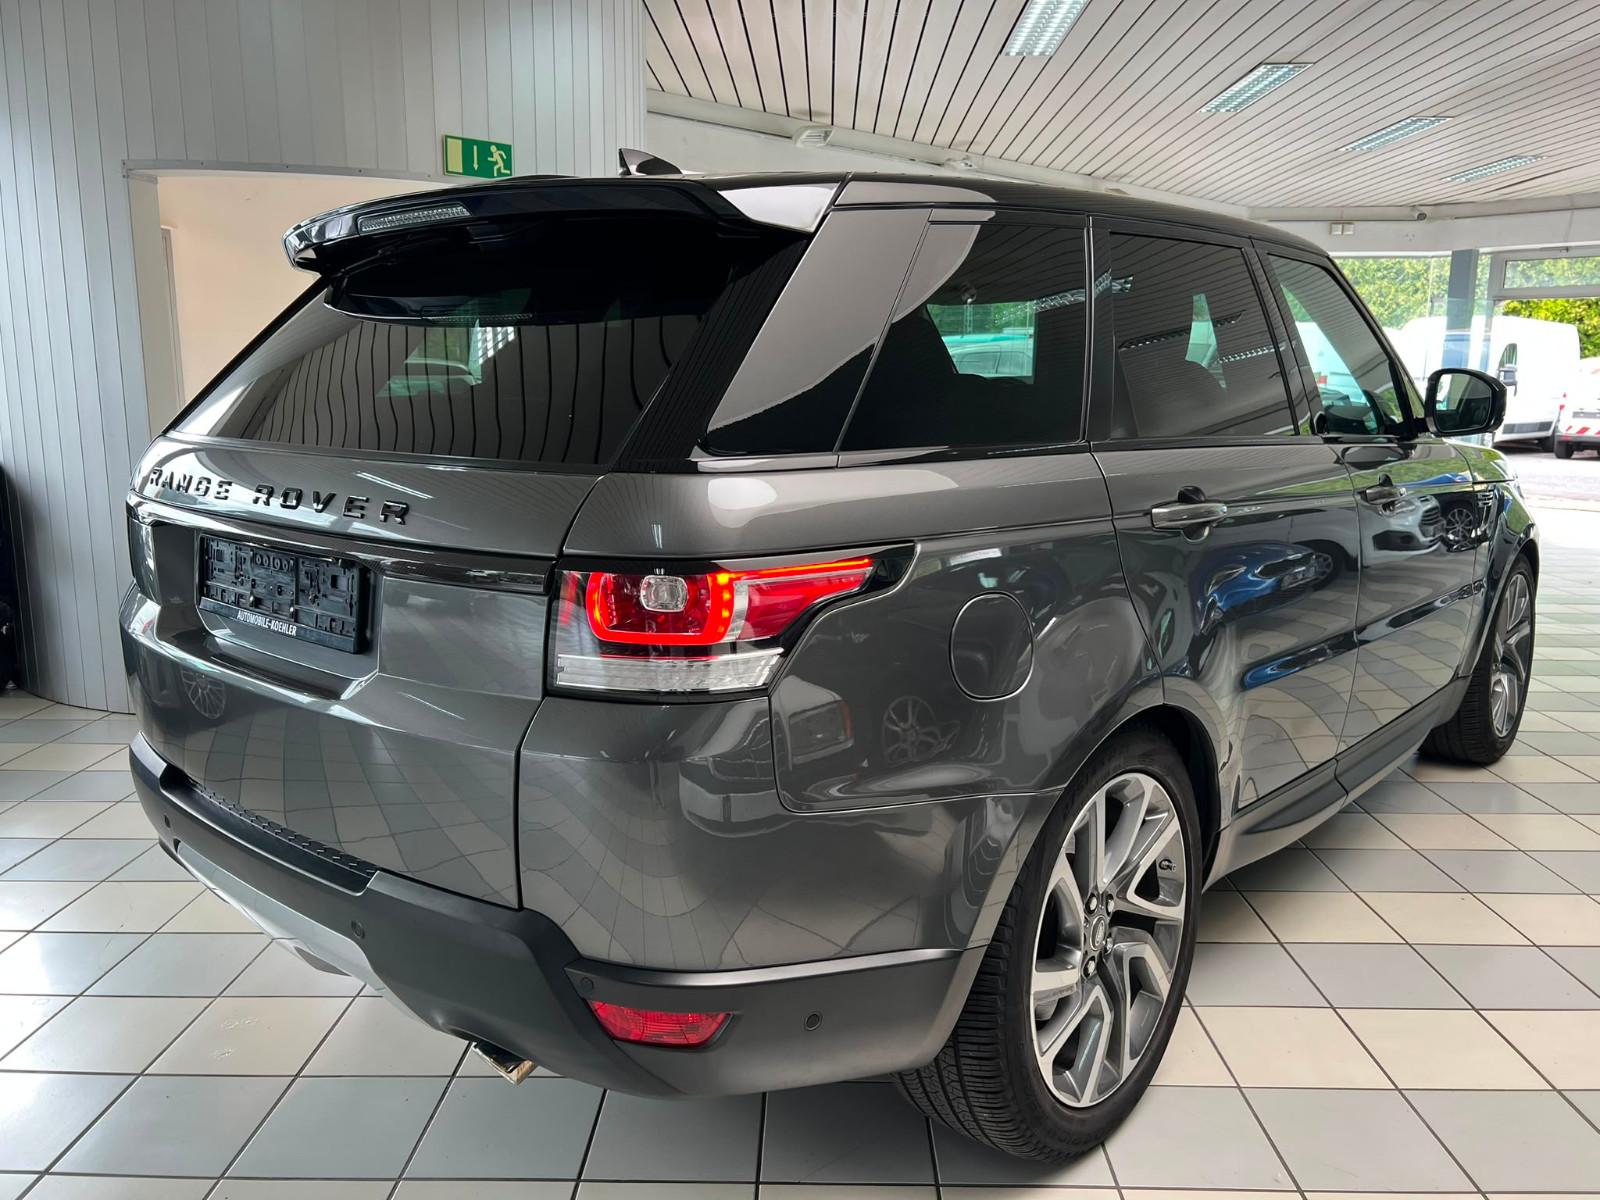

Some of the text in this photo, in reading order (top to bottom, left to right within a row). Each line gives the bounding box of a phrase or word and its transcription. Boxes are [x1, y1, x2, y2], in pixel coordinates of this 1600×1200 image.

[149, 468, 410, 525] RANGE ROVER
[236, 609, 297, 636] AUTOMOBILE-KOEHLER
